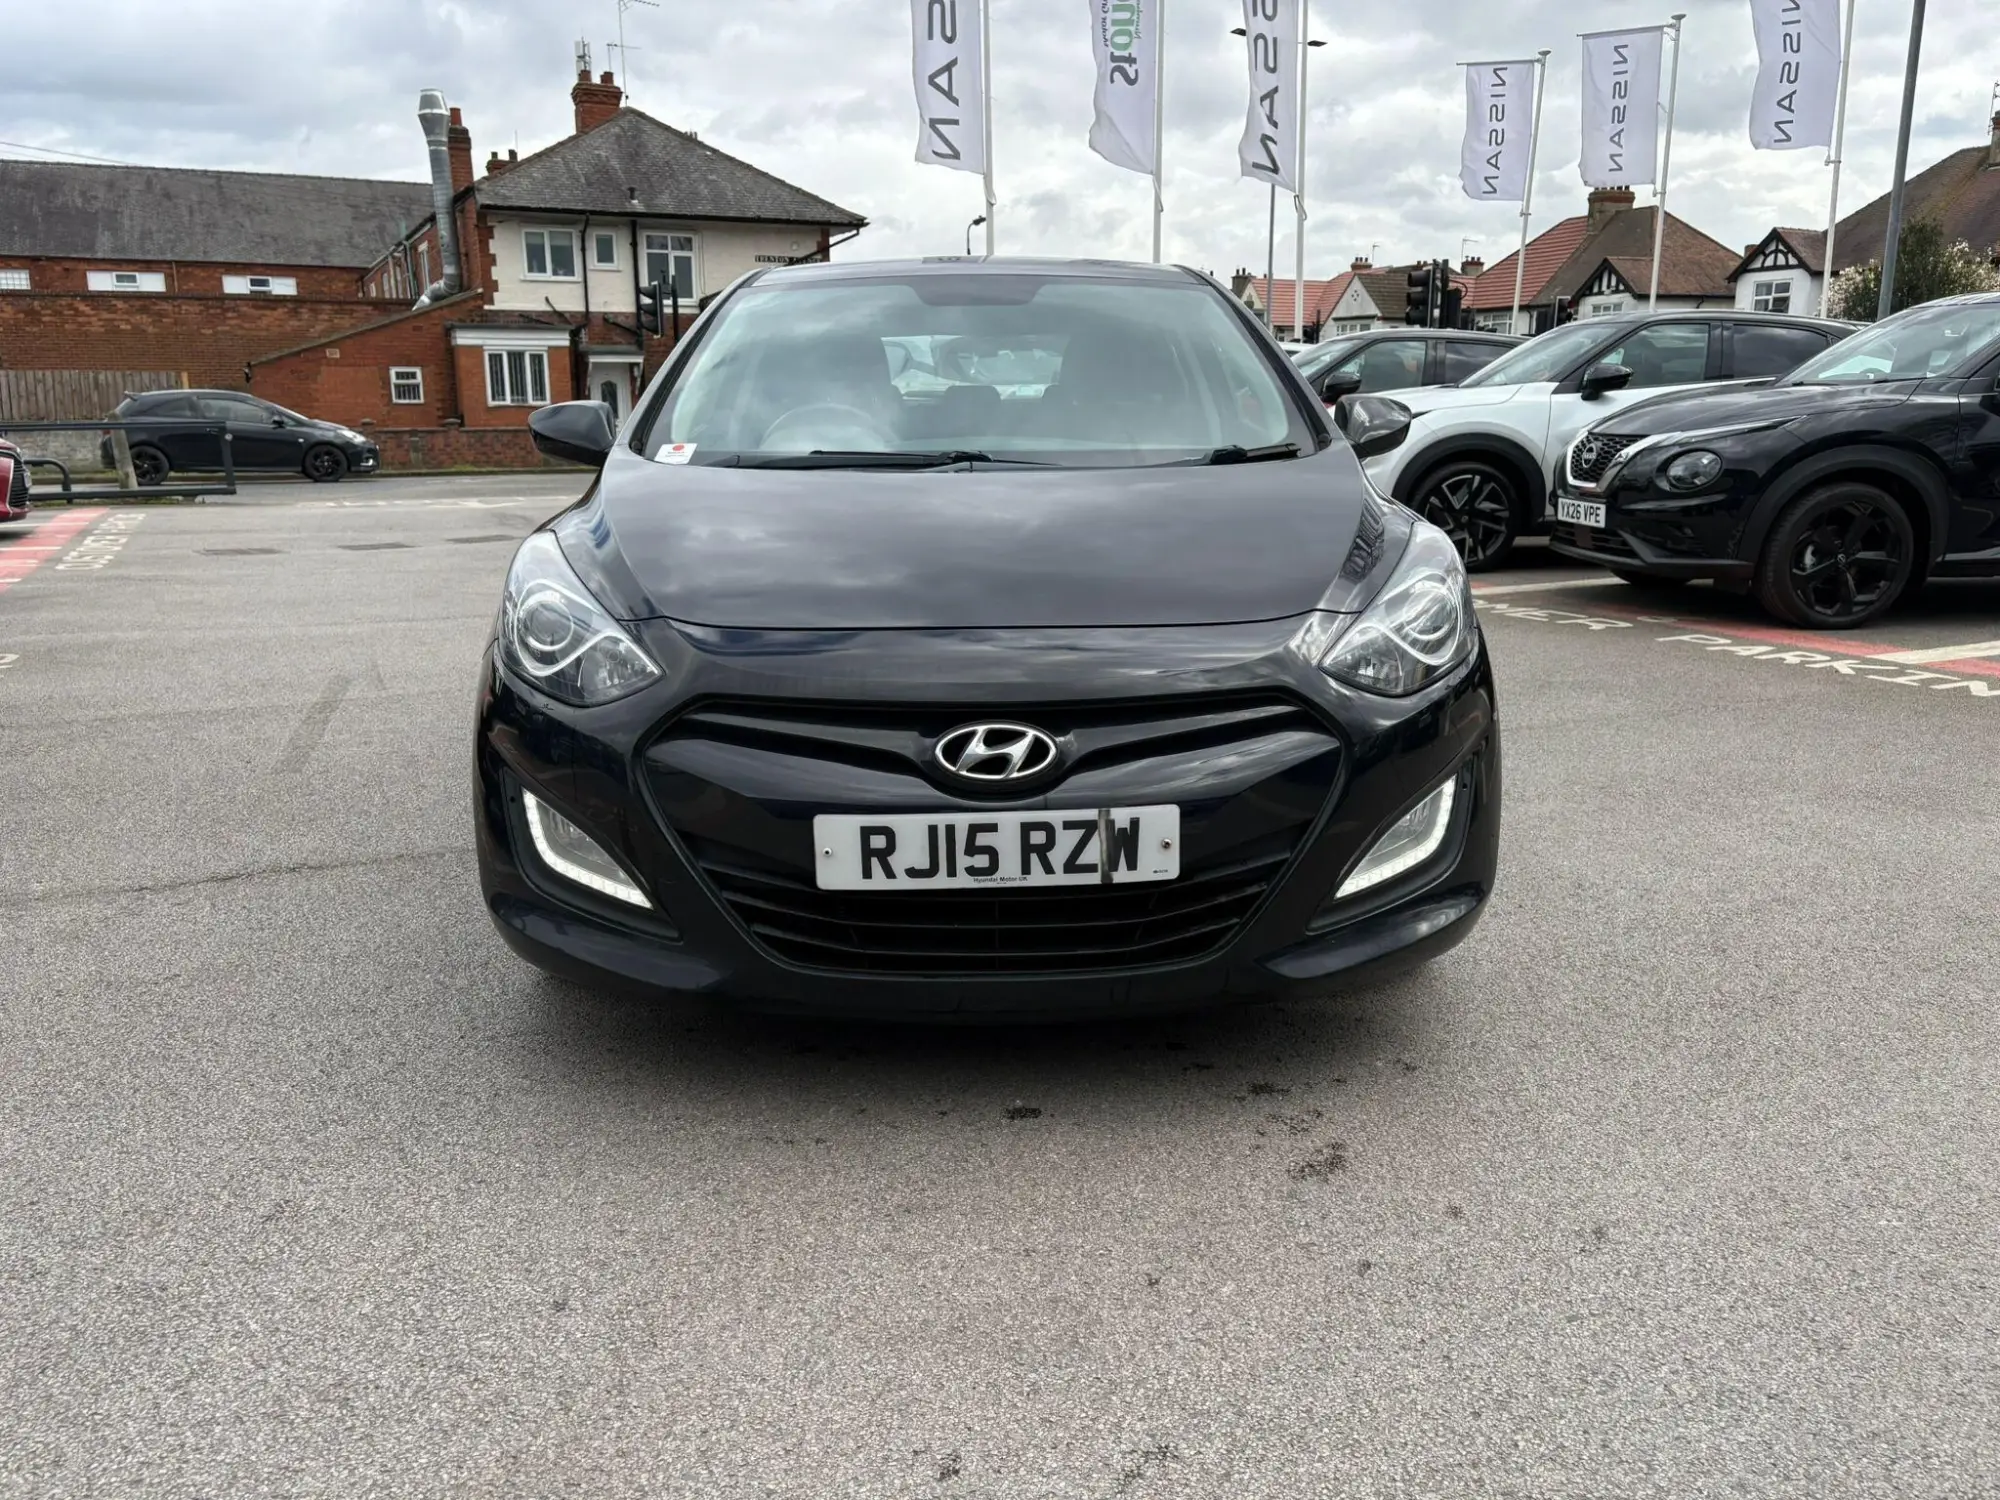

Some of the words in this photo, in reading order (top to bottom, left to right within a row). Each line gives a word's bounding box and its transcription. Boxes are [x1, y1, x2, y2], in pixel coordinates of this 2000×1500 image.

[1561, 500, 1581, 520] YX26
[1584, 504, 1601, 524] VPE
[859, 822, 1000, 880] RJ15
[1019, 816, 1140, 876] RZW
